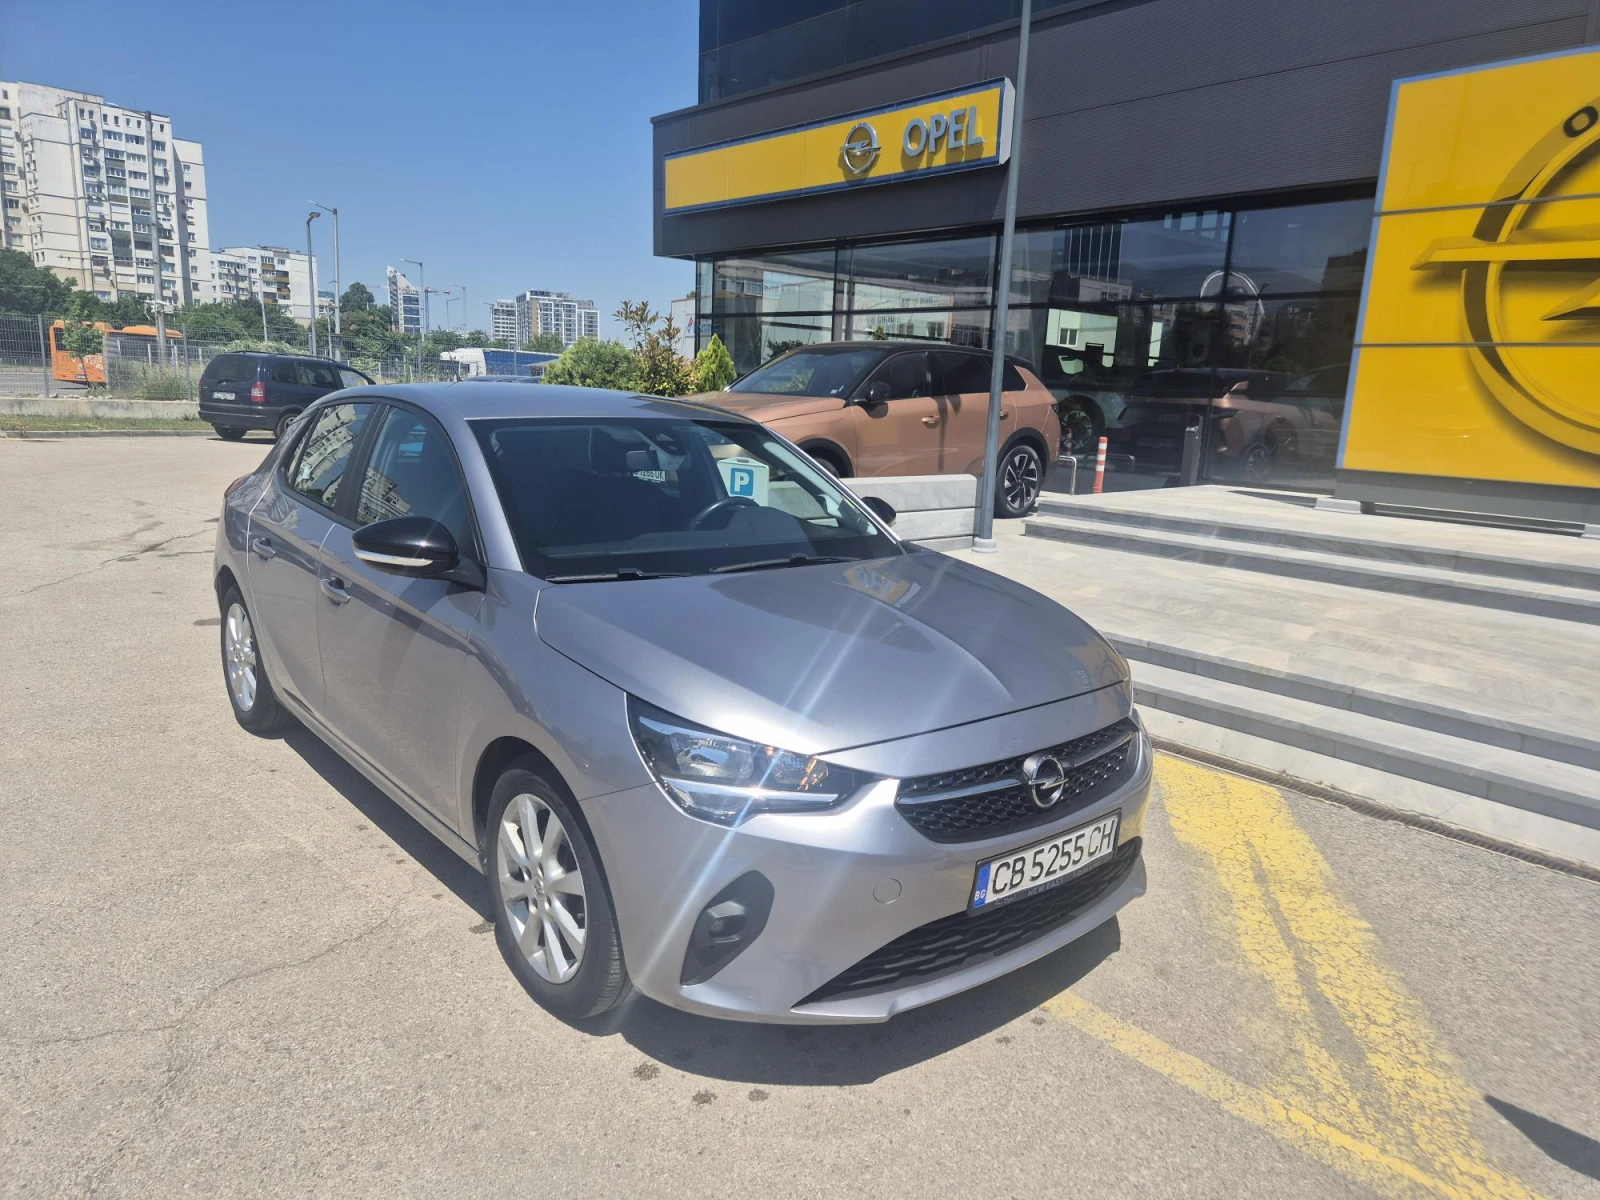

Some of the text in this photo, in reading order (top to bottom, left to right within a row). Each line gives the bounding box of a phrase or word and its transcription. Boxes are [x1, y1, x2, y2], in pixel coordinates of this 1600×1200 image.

[903, 106, 985, 157] OPEL
[733, 471, 750, 492] P
[992, 820, 1115, 894] CB 5255 CH
[974, 889, 987, 900] BG
[1028, 878, 1065, 897] NEW EAST
